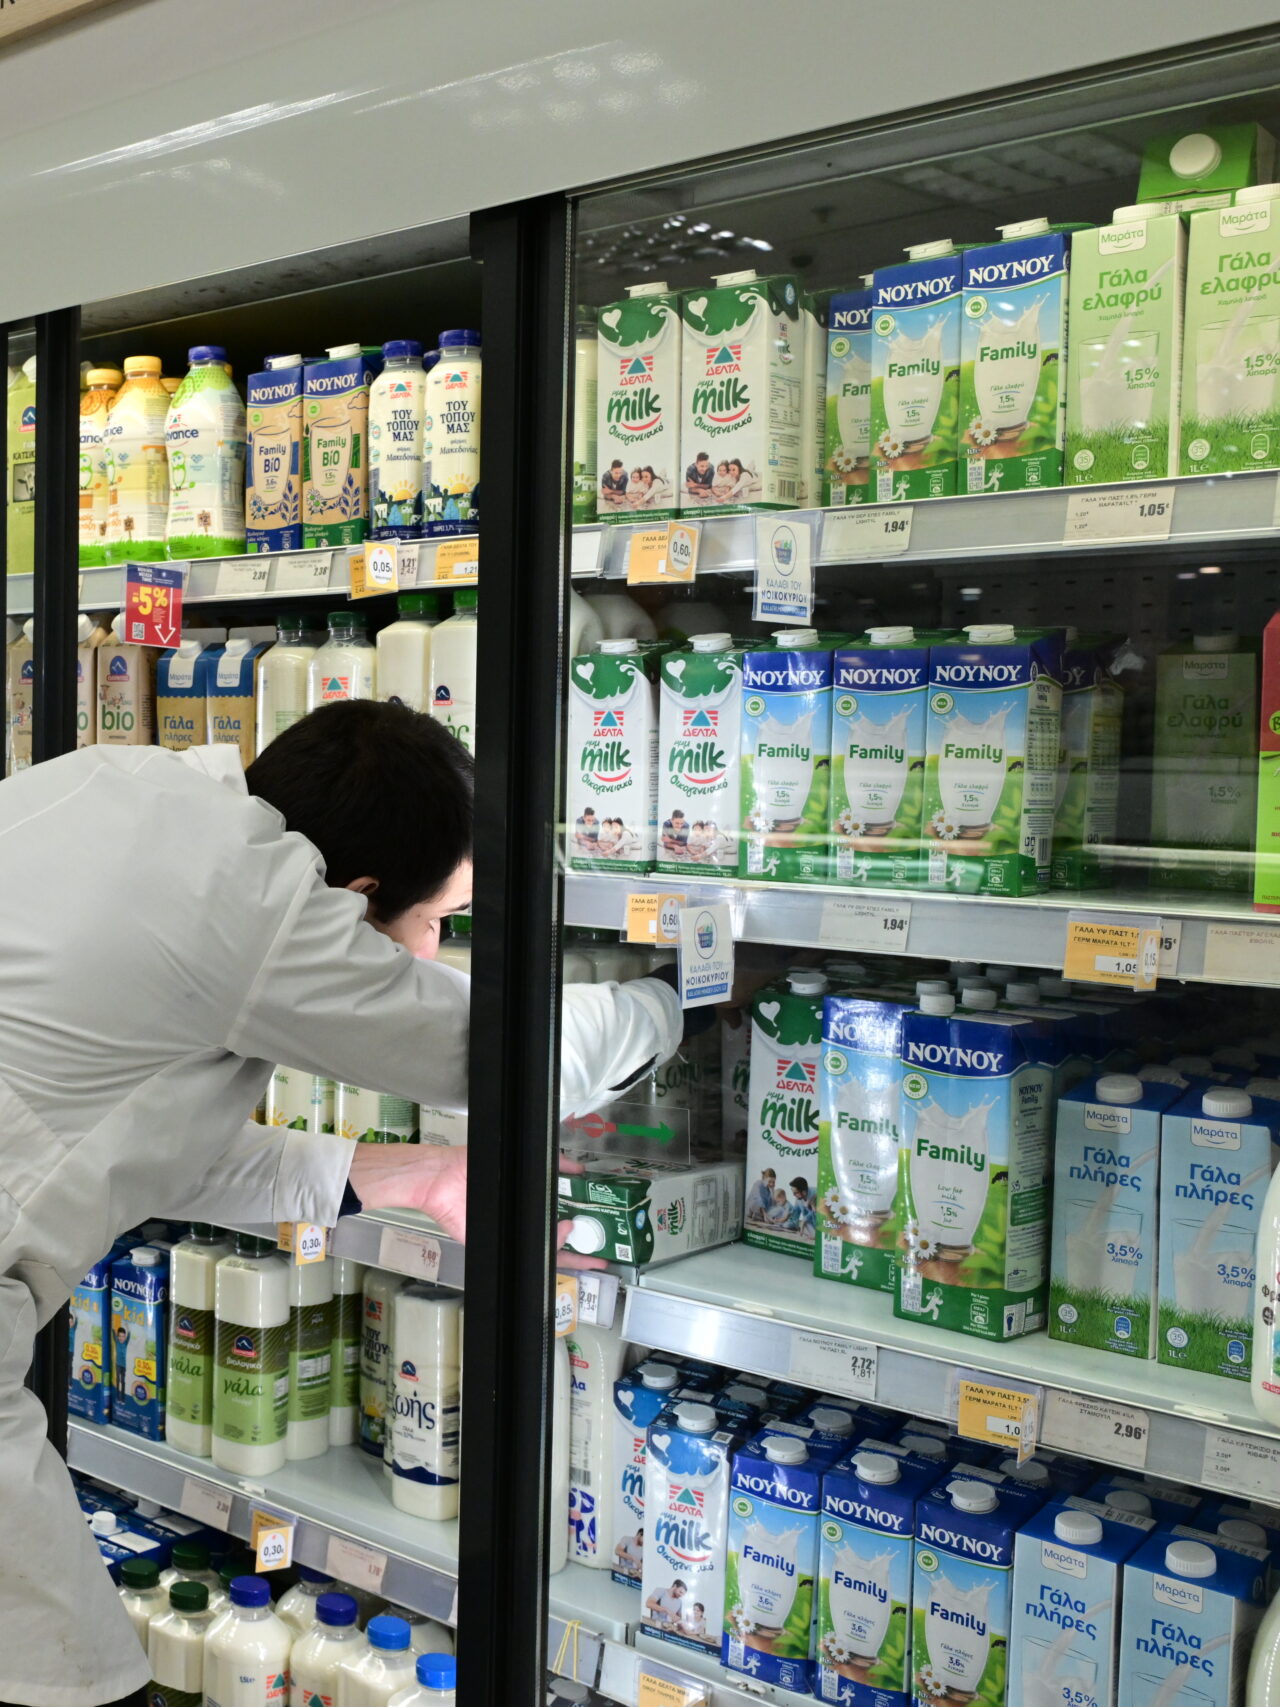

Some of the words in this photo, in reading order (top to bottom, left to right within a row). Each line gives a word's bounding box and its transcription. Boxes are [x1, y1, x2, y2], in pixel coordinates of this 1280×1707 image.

[1222, 210, 1268, 226] Μαράτα
[1100, 229, 1145, 245] Μαράτα
[968, 254, 1055, 285] NOYNOY
[1218, 251, 1272, 273] Γάλα
[1098, 268, 1148, 290] Γάλα
[877, 275, 956, 305] NOYNOY
[1082, 283, 1163, 313] ελαφρύ
[980, 341, 1037, 363] Family
[1244, 352, 1280, 370] 1,5%
[706, 363, 741, 377] ΔΕΛΤΑ
[888, 359, 940, 379] Family
[1124, 368, 1160, 383] 1,5%
[1246, 367, 1278, 377] λιπαρά
[306, 373, 358, 393] NOYNOY
[620, 374, 654, 386] ΔΕΛΤΑ
[1126, 381, 1157, 390] λιπαρά
[250, 382, 299, 402] NOYNOY
[692, 377, 751, 415] milk
[391, 409, 412, 420] ΤΟΥ
[445, 400, 469, 412] ΤΟΥ
[606, 387, 662, 424] milk
[386, 420, 420, 432] ΤΟΠΟΥ
[440, 411, 476, 424] ΤΟΠΟΥ
[392, 431, 414, 442] ΜΑΣ
[446, 422, 470, 435] ΜΑΣ
[258, 443, 287, 456] Family
[317, 436, 347, 449] Family
[748, 669, 825, 687] NOYNOY
[839, 668, 921, 685] NOYNOY
[935, 665, 1022, 682] NOYNOY
[322, 689, 348, 699] ΔΕΛΤΑ
[1182, 694, 1230, 710] Γάλα
[101, 705, 135, 731] bio
[163, 716, 195, 730] Γάλα
[213, 716, 241, 730] Γάλα
[1167, 710, 1244, 732] ελαφρύ
[164, 733, 193, 743] πλήρες
[213, 733, 240, 743] πλήρες
[593, 727, 624, 737] ΔΕΛΤΑ
[683, 728, 718, 738] ΔΕΛΤΑ
[580, 741, 632, 772] milk
[668, 741, 726, 773] milk
[757, 743, 810, 762] Family
[849, 744, 904, 763] Family
[944, 743, 1003, 763] Family
[1208, 785, 1241, 799] 1,5%
[1074, 925, 1095, 934] ΓΑΛΑ
[1108, 929, 1129, 937] ΠΑΣΤ
[1091, 938, 1118, 947] ΜΑΡΑΤΑ
[907, 1041, 1003, 1072] NOYNOY
[776, 1080, 815, 1095] ΔΕΛΤΑ
[760, 1097, 820, 1133] milk
[1086, 1109, 1128, 1125] Μαράτα
[837, 1111, 899, 1142] Family
[1193, 1125, 1239, 1141] Μαράτα
[917, 1138, 986, 1172] Family
[1083, 1146, 1130, 1169] Γάλα
[1070, 1163, 1142, 1192] πλήρες
[1189, 1163, 1241, 1186] Γάλα
[1175, 1182, 1255, 1211] πλήρες
[940, 1205, 958, 1218] 1,5%
[1106, 1242, 1144, 1261] 3,5%
[1111, 1255, 1140, 1267] λιπαρά
[1217, 1263, 1256, 1283] 3,5%
[1222, 1276, 1253, 1289] λιπαρά
[223, 1376, 265, 1397] γάλα
[965, 1385, 984, 1395] ΓΑΛΑ
[985, 1389, 996, 1397] ΥΨ
[997, 1391, 1016, 1402] ΠΑΣΤ
[736, 1472, 814, 1508] NOYNOY
[669, 1502, 704, 1519] ΔΕΛΤΑ
[825, 1495, 904, 1531] NOYNOY
[655, 1517, 713, 1552] milk
[921, 1524, 1004, 1561] NOYNOY
[743, 1545, 796, 1577] Family
[1044, 1547, 1085, 1569] Μαράτα
[834, 1571, 888, 1603] Family
[1155, 1580, 1200, 1603] Μαράτα
[1039, 1584, 1086, 1614] Γάλα
[930, 1602, 987, 1636] Family
[1025, 1602, 1097, 1641] πλήρες
[1151, 1618, 1202, 1650] Γάλα
[1135, 1637, 1215, 1677] πλήρες
[1062, 1687, 1098, 1707] 3,5%
